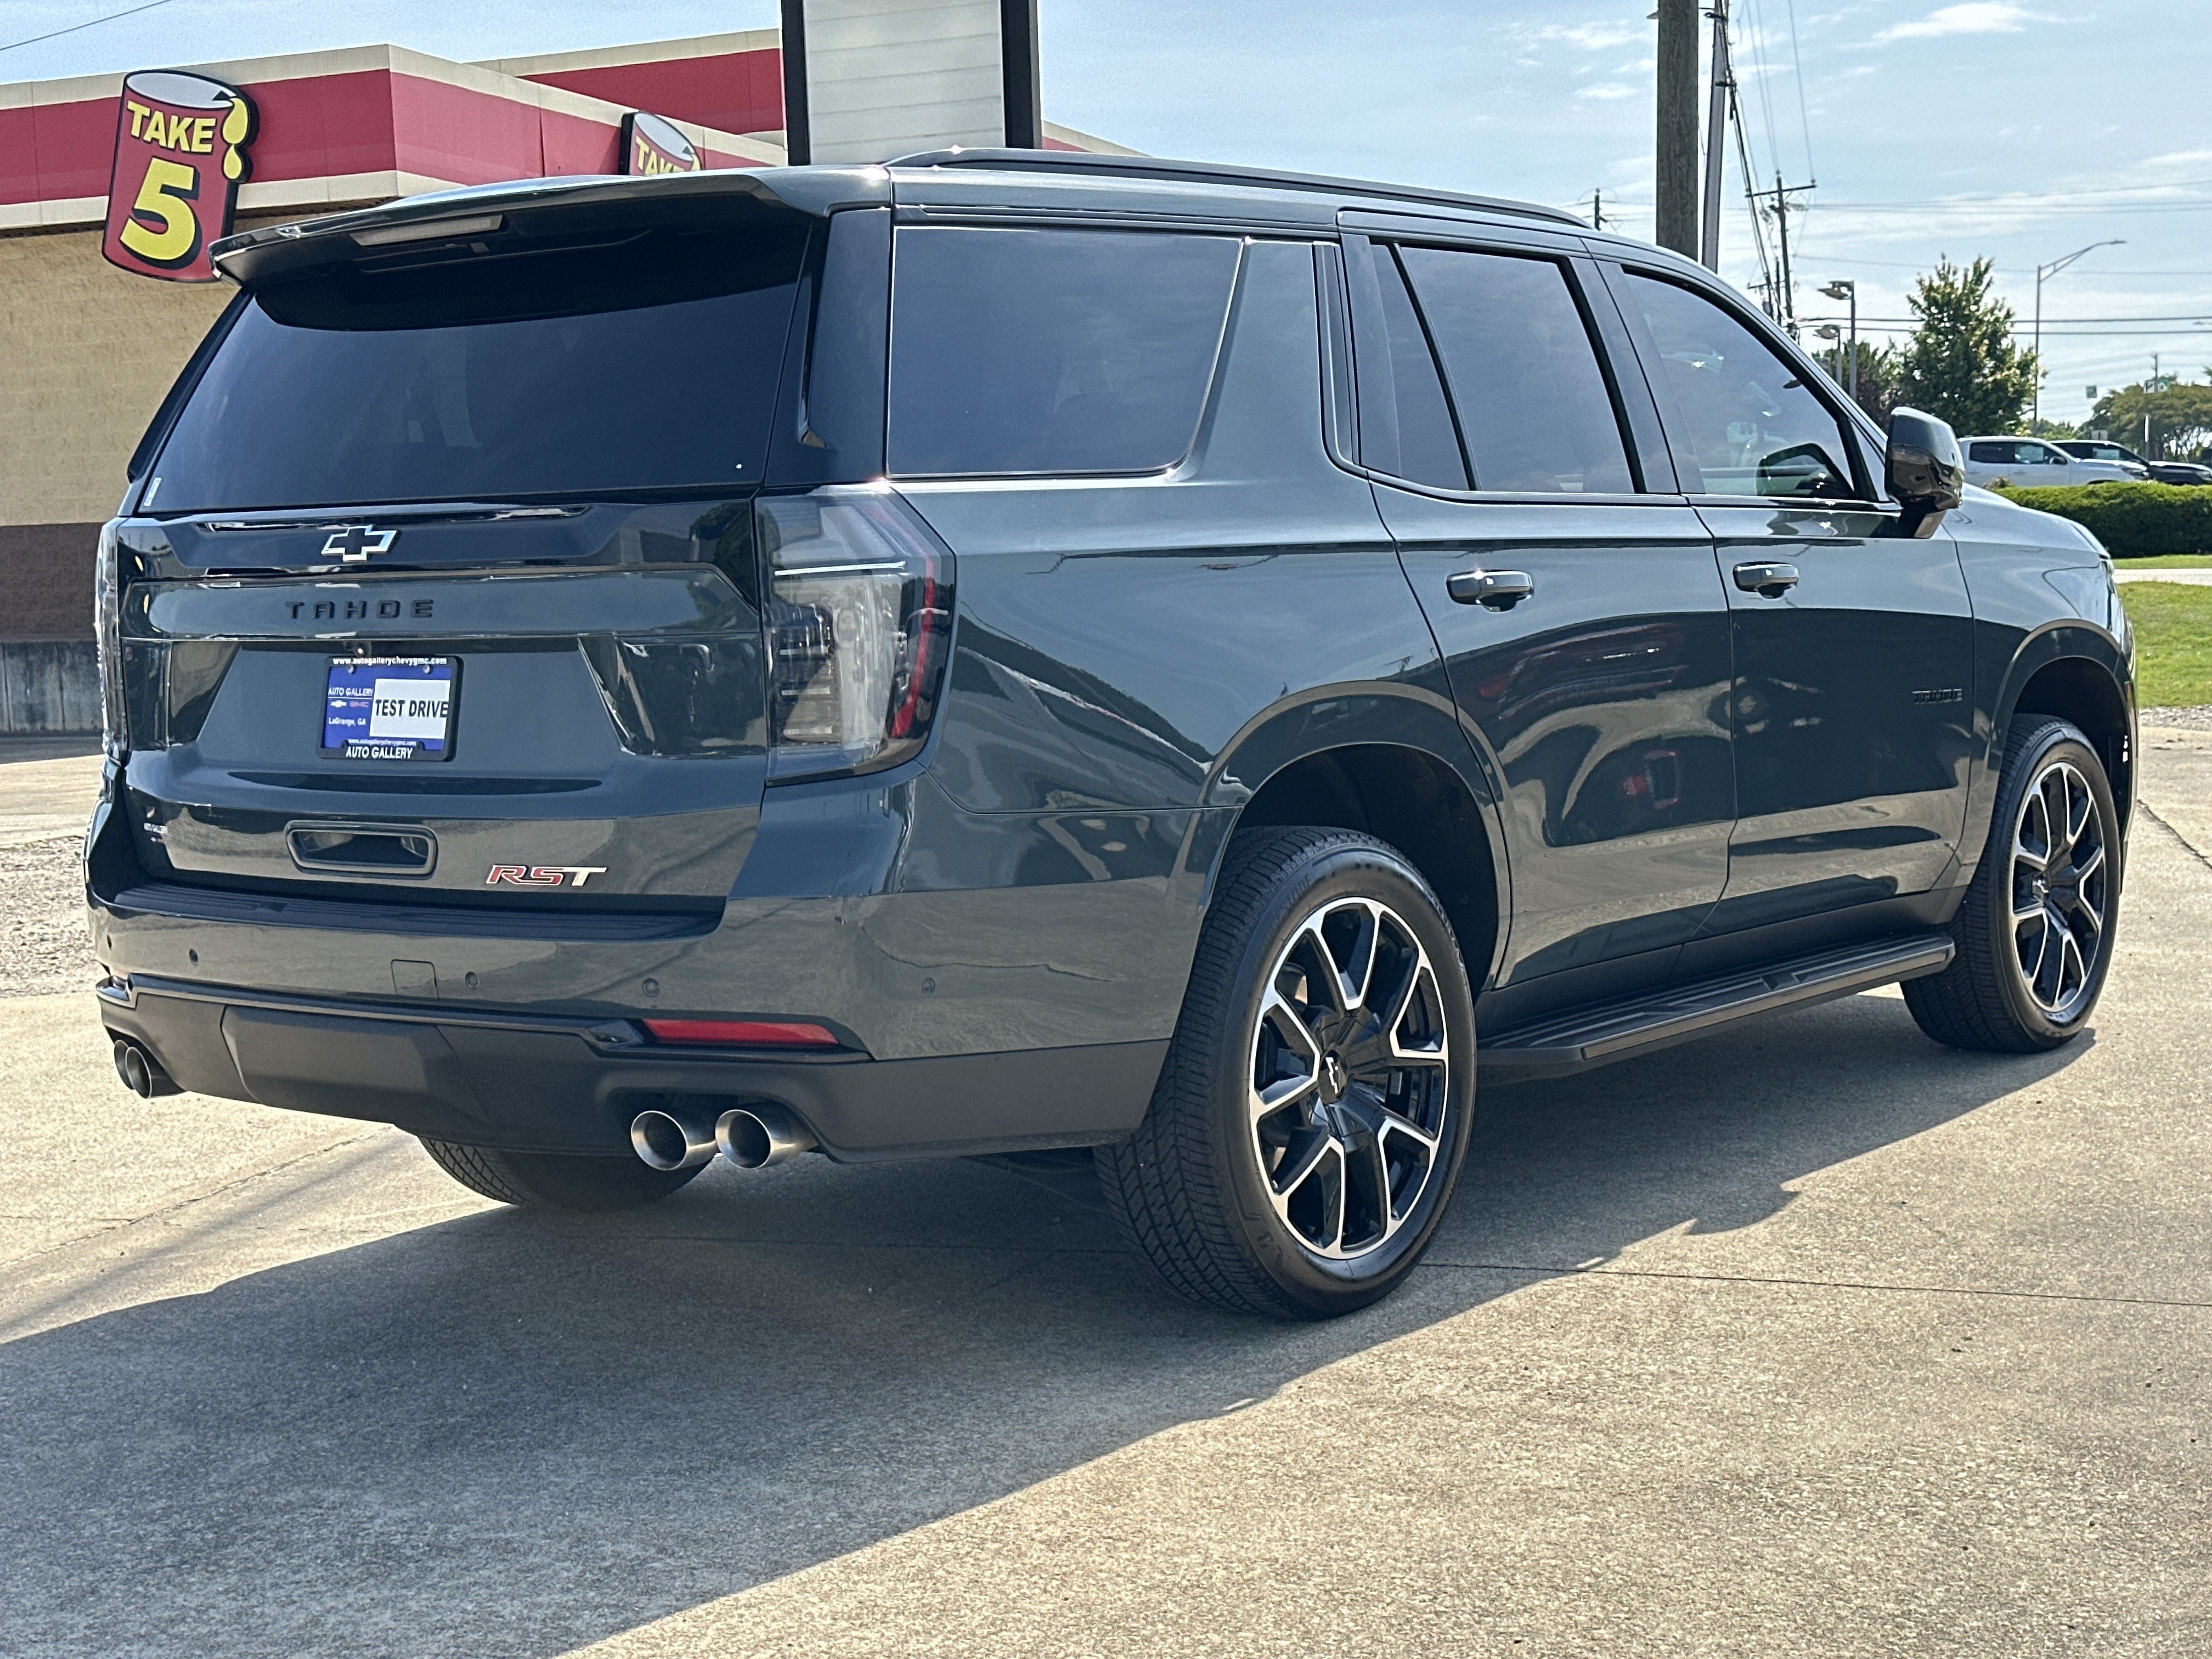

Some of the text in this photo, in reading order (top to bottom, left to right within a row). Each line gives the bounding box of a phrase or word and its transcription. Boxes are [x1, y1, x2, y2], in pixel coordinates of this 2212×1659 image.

[127, 100, 217, 154] TAKE
[119, 156, 198, 261] 5
[285, 599, 434, 619] TAHOE
[328, 687, 373, 696] AUTO GALLERY
[375, 699, 449, 718] TEST DRIVE
[345, 746, 413, 759] AUTO GALLERY
[486, 864, 607, 887] RST
